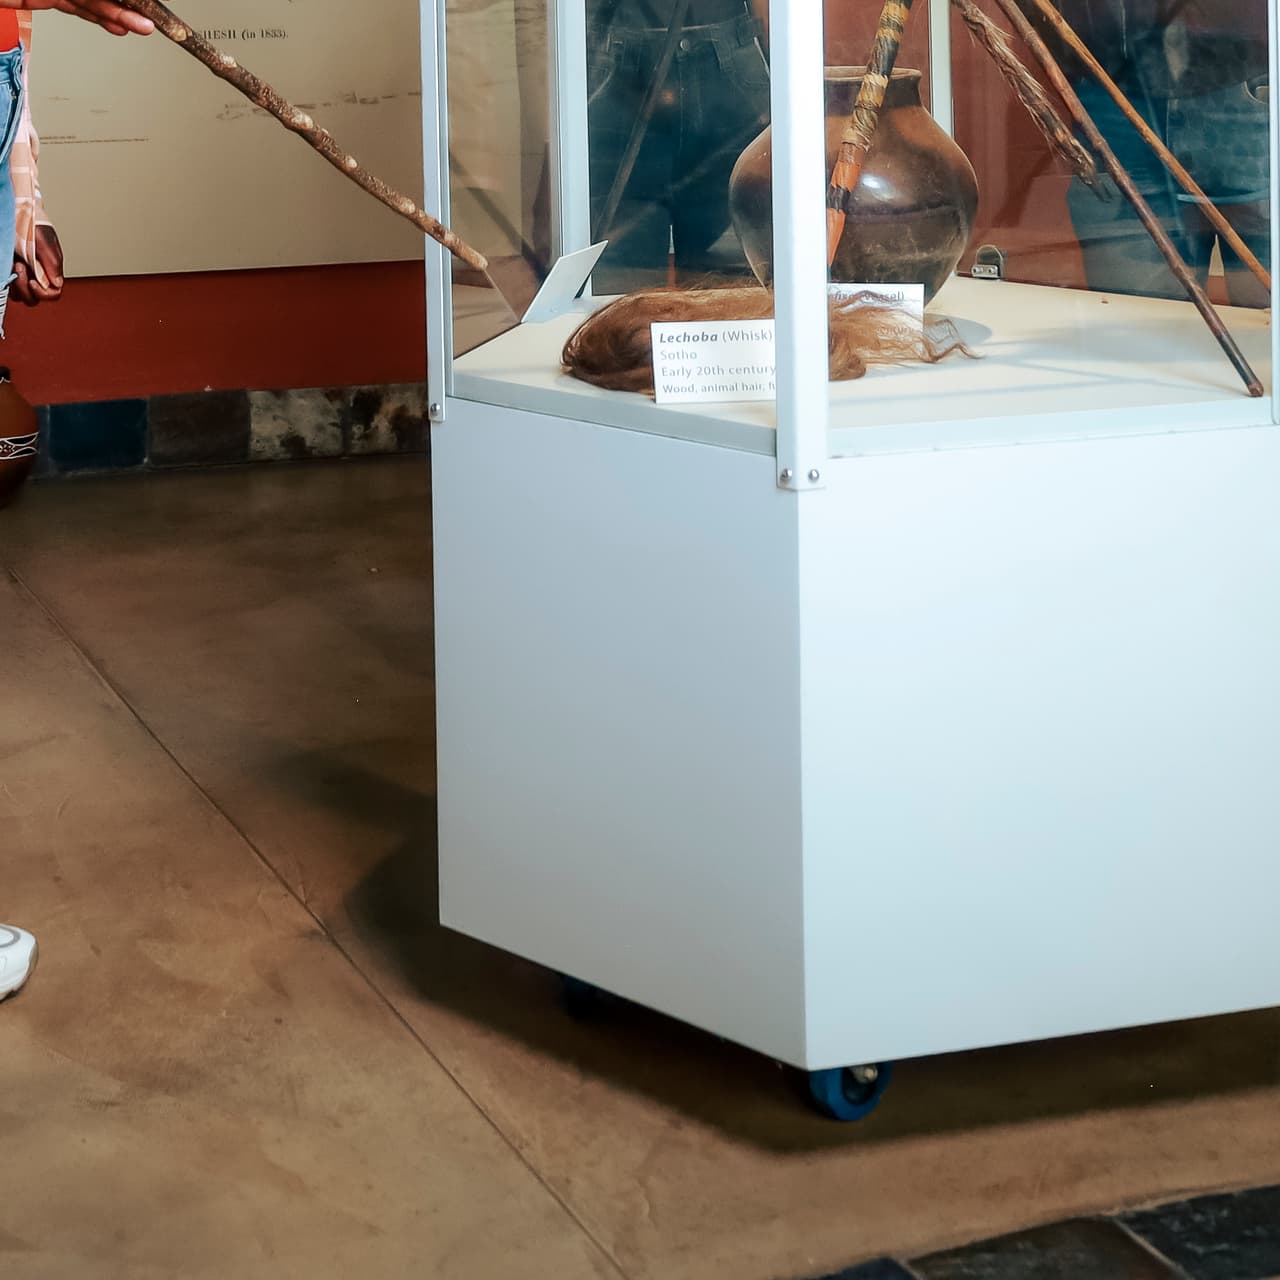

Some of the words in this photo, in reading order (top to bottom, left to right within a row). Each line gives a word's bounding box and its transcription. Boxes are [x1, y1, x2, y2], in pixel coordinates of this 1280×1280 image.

[241, 28, 256, 41] (in
[659, 331, 719, 344] Lechoba
[722, 328, 773, 343] (Whisk)
[660, 349, 698, 361] Sotho
[661, 366, 692, 379] Early
[696, 365, 725, 376] 20th
[728, 365, 776, 376] century
[662, 383, 699, 394] Wood,
[701, 382, 739, 393] animal
